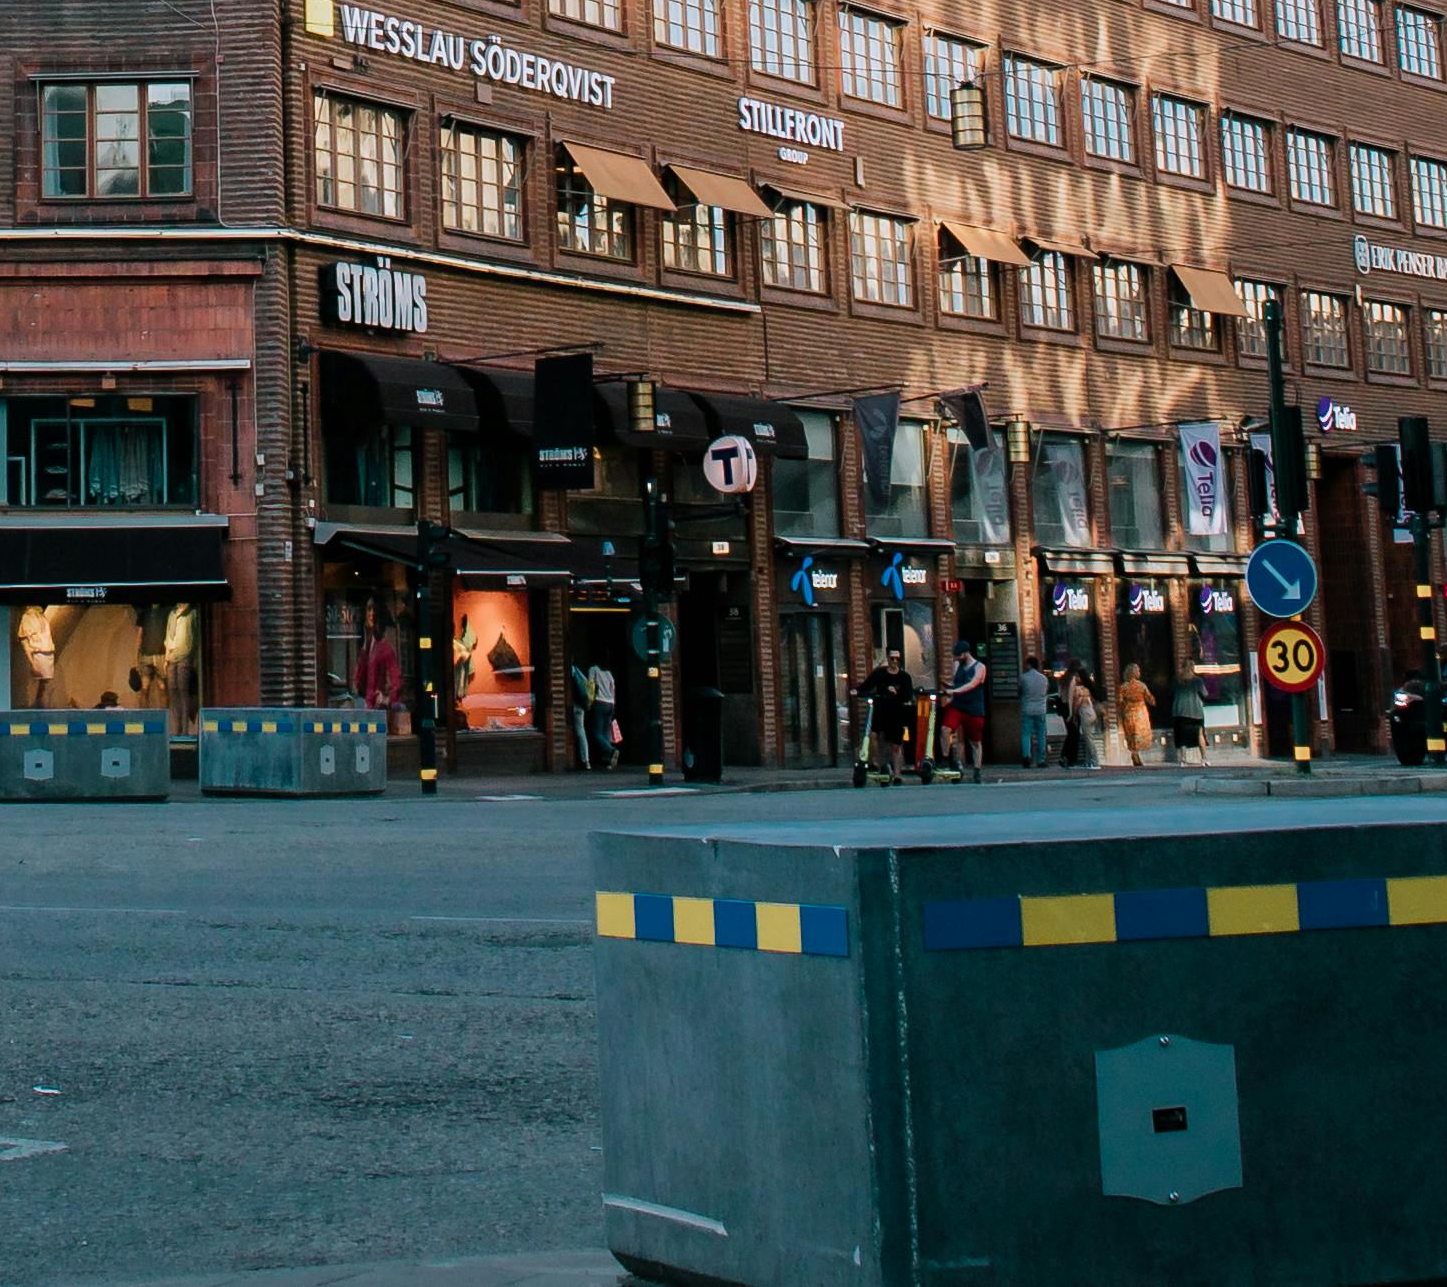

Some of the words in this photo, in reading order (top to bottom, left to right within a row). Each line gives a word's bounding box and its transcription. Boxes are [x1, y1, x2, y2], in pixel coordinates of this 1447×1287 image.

[339, 4, 464, 70] WESSLAU
[469, 34, 616, 109] SÖDERQVIST
[738, 96, 844, 152] STILLFRONT
[778, 147, 809, 165] GROUP
[1370, 244, 1395, 271] ERIK
[1395, 249, 1436, 279] PENSER
[335, 256, 428, 333] STRÖMS
[1334, 406, 1357, 431] Telia
[710, 446, 739, 486] T
[1196, 471, 1213, 517] Telia
[812, 569, 837, 588] telenor
[901, 565, 927, 584] telenor
[1066, 588, 1089, 611] Telia
[1142, 588, 1165, 611] Telia
[1212, 591, 1234, 612] Telia
[1271, 638, 1315, 673] 30
